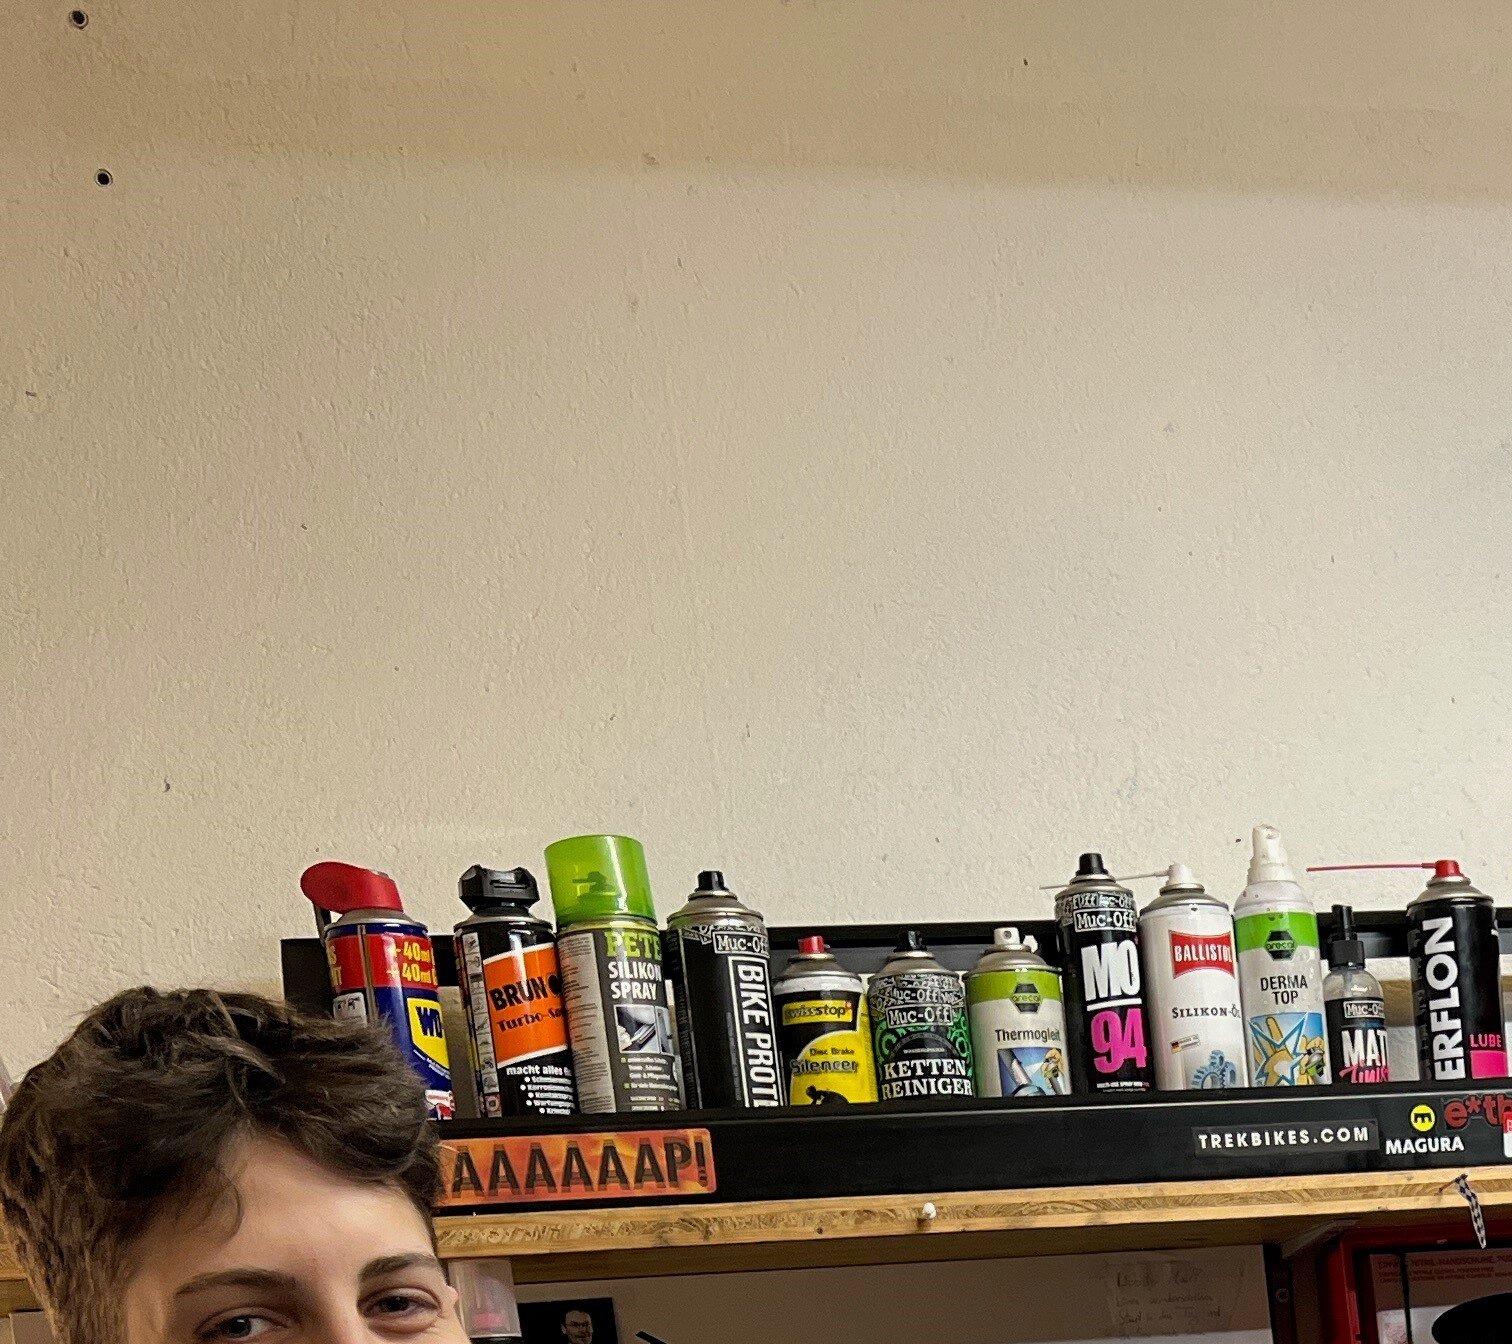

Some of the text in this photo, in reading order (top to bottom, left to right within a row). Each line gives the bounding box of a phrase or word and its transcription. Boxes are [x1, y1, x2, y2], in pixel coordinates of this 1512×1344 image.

[1076, 909, 1136, 930] Muc-Off
[1173, 944, 1233, 963] BALLISTOL
[608, 961, 662, 982] SILIKON
[1080, 939, 1142, 1002] MO
[610, 982, 658, 1000] SPRAY
[1260, 974, 1309, 992] DERMA
[737, 964, 770, 1027] BIKE
[1273, 989, 1299, 1005] TOP
[889, 1005, 952, 1025] Muc-Off
[1090, 1007, 1147, 1074] 94
[1469, 1033, 1502, 1048] LUBE
[789, 1058, 860, 1077] Silencer
[883, 1058, 966, 1078] KETTEN
[881, 1077, 973, 1100] REINIGER
[1197, 1126, 1370, 1150] TREKBIKES.COM
[1385, 1135, 1466, 1156] MAGURA
